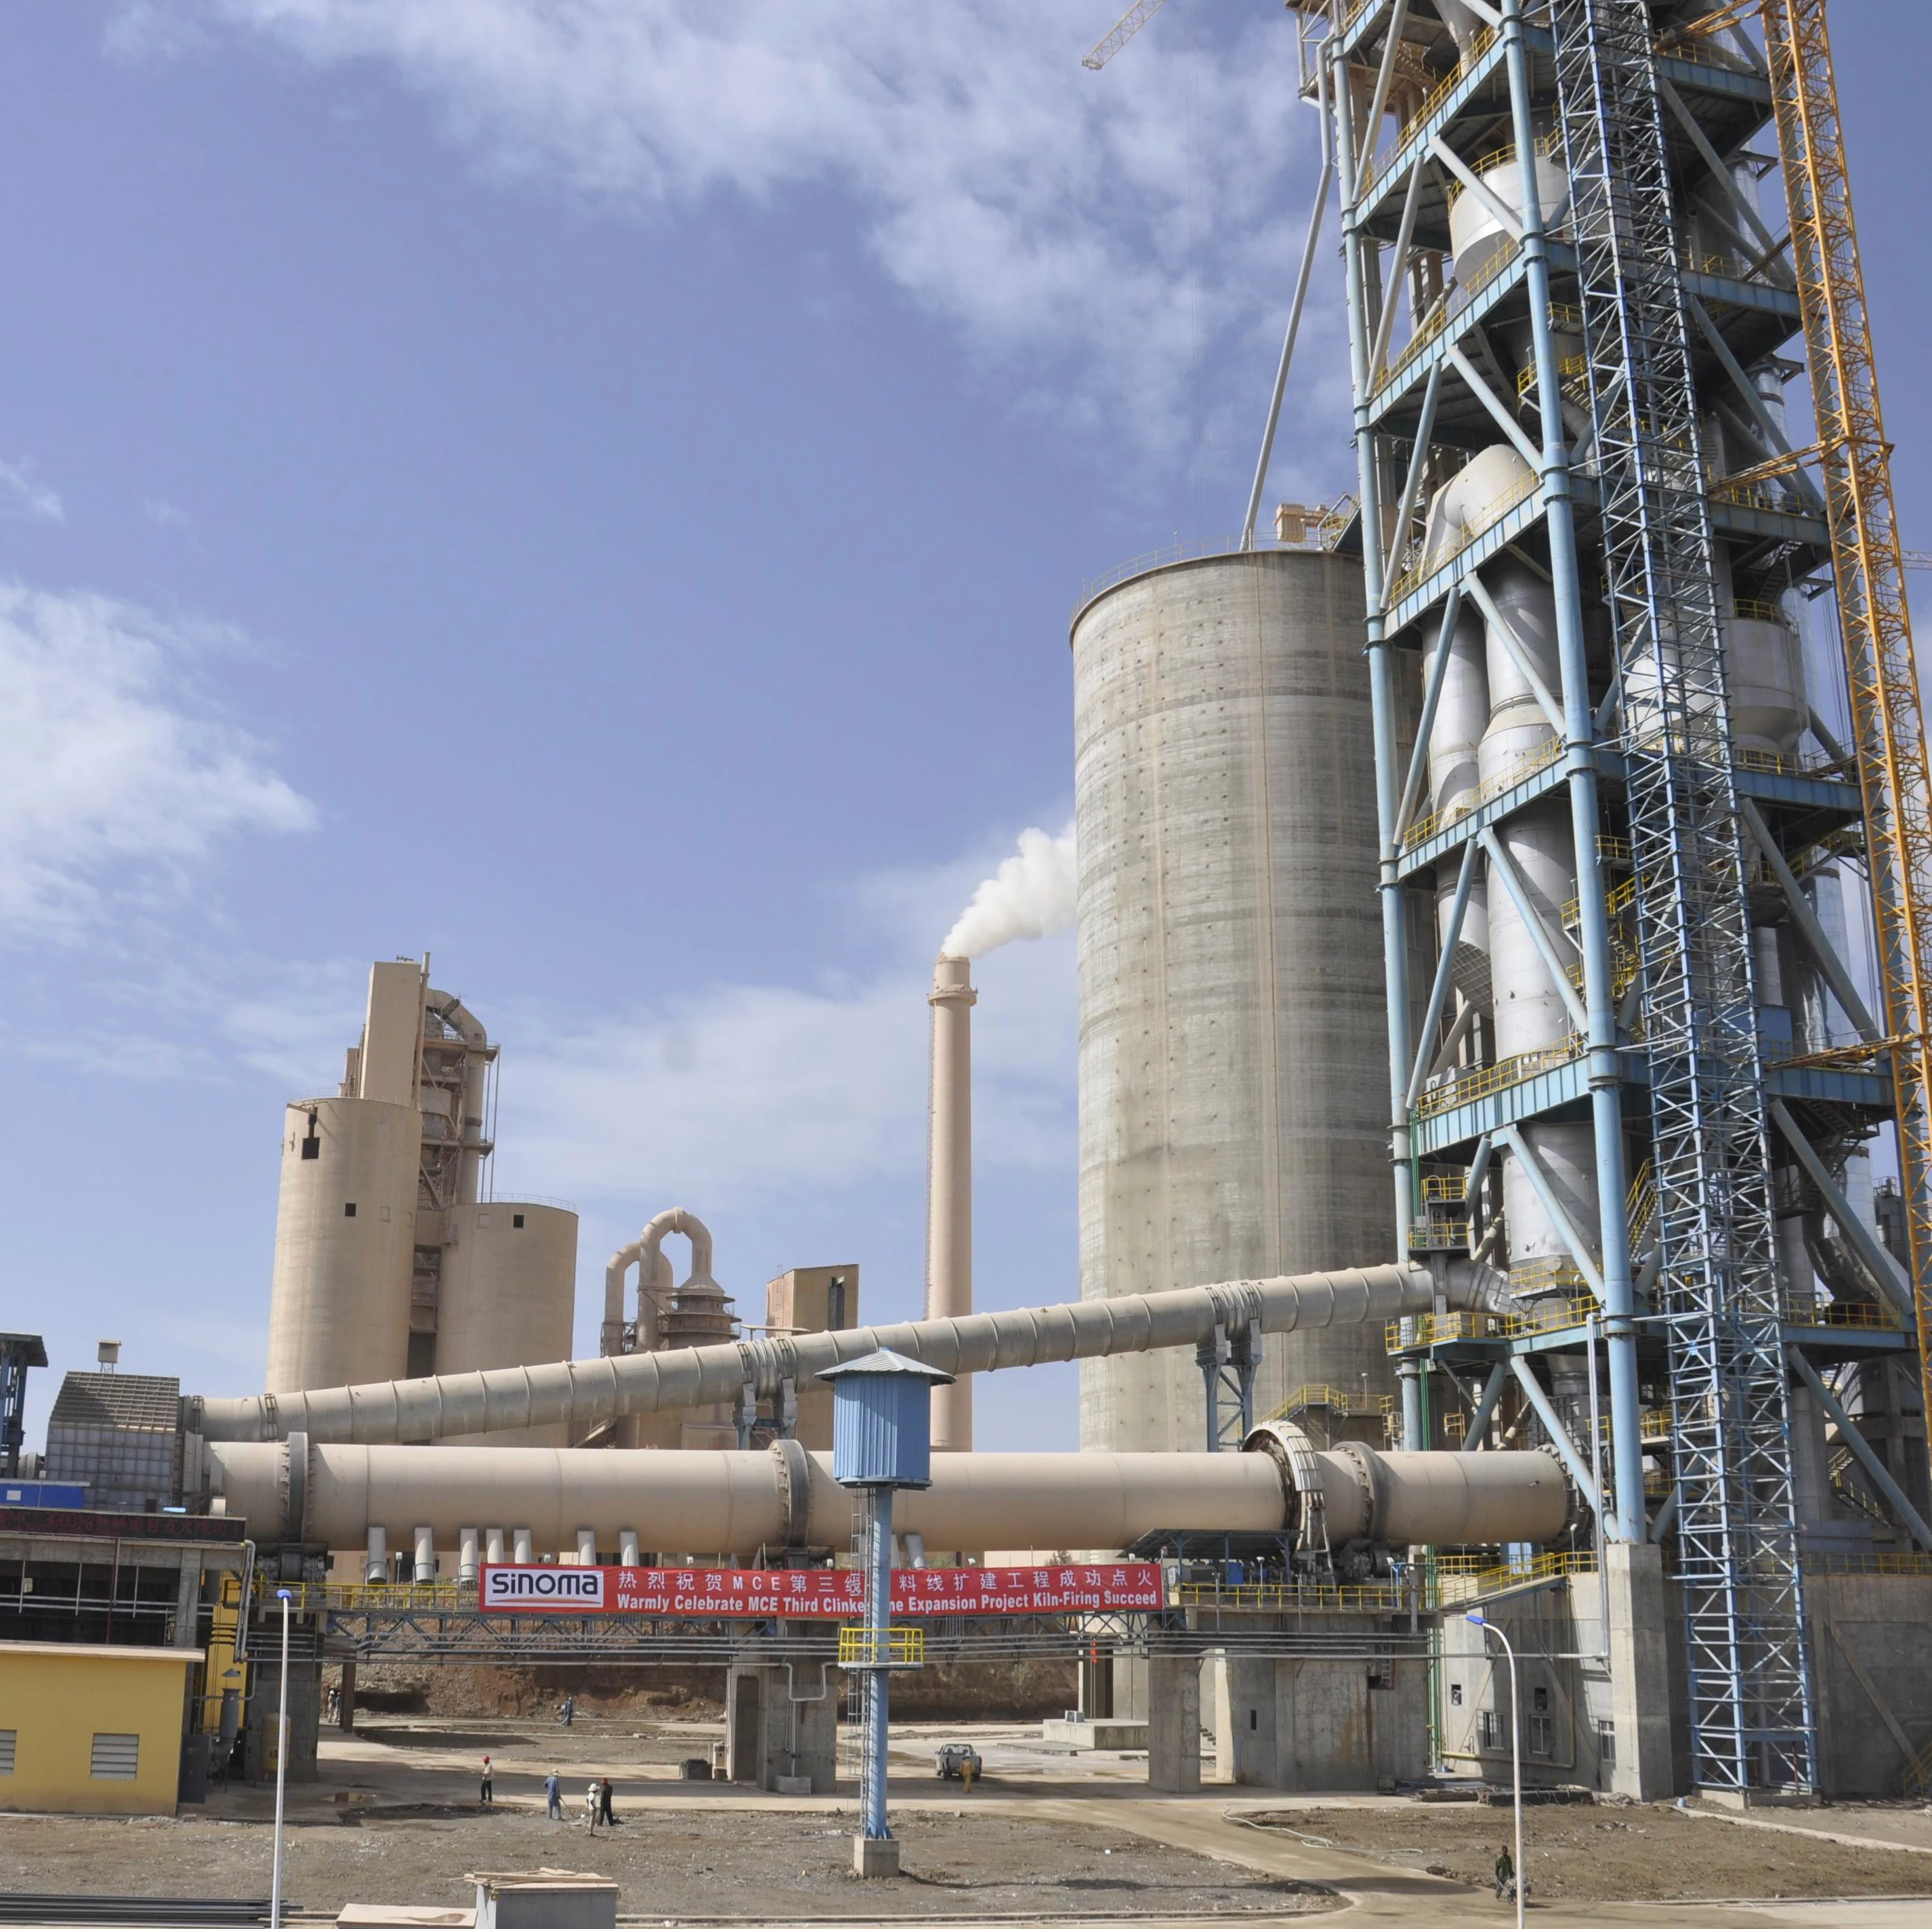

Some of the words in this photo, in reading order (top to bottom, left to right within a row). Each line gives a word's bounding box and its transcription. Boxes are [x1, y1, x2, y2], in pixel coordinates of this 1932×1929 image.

[617, 1594, 669, 1613] Warmly
[675, 1594, 743, 1611] Celebrate
[748, 1596, 778, 1611] MCE
[783, 1597, 818, 1612] Third
[908, 1596, 976, 1614] Expansion
[982, 1594, 1028, 1611] Project
[1033, 1591, 1099, 1608] Kiln-Firing
[1104, 1590, 1156, 1605] Succeed
